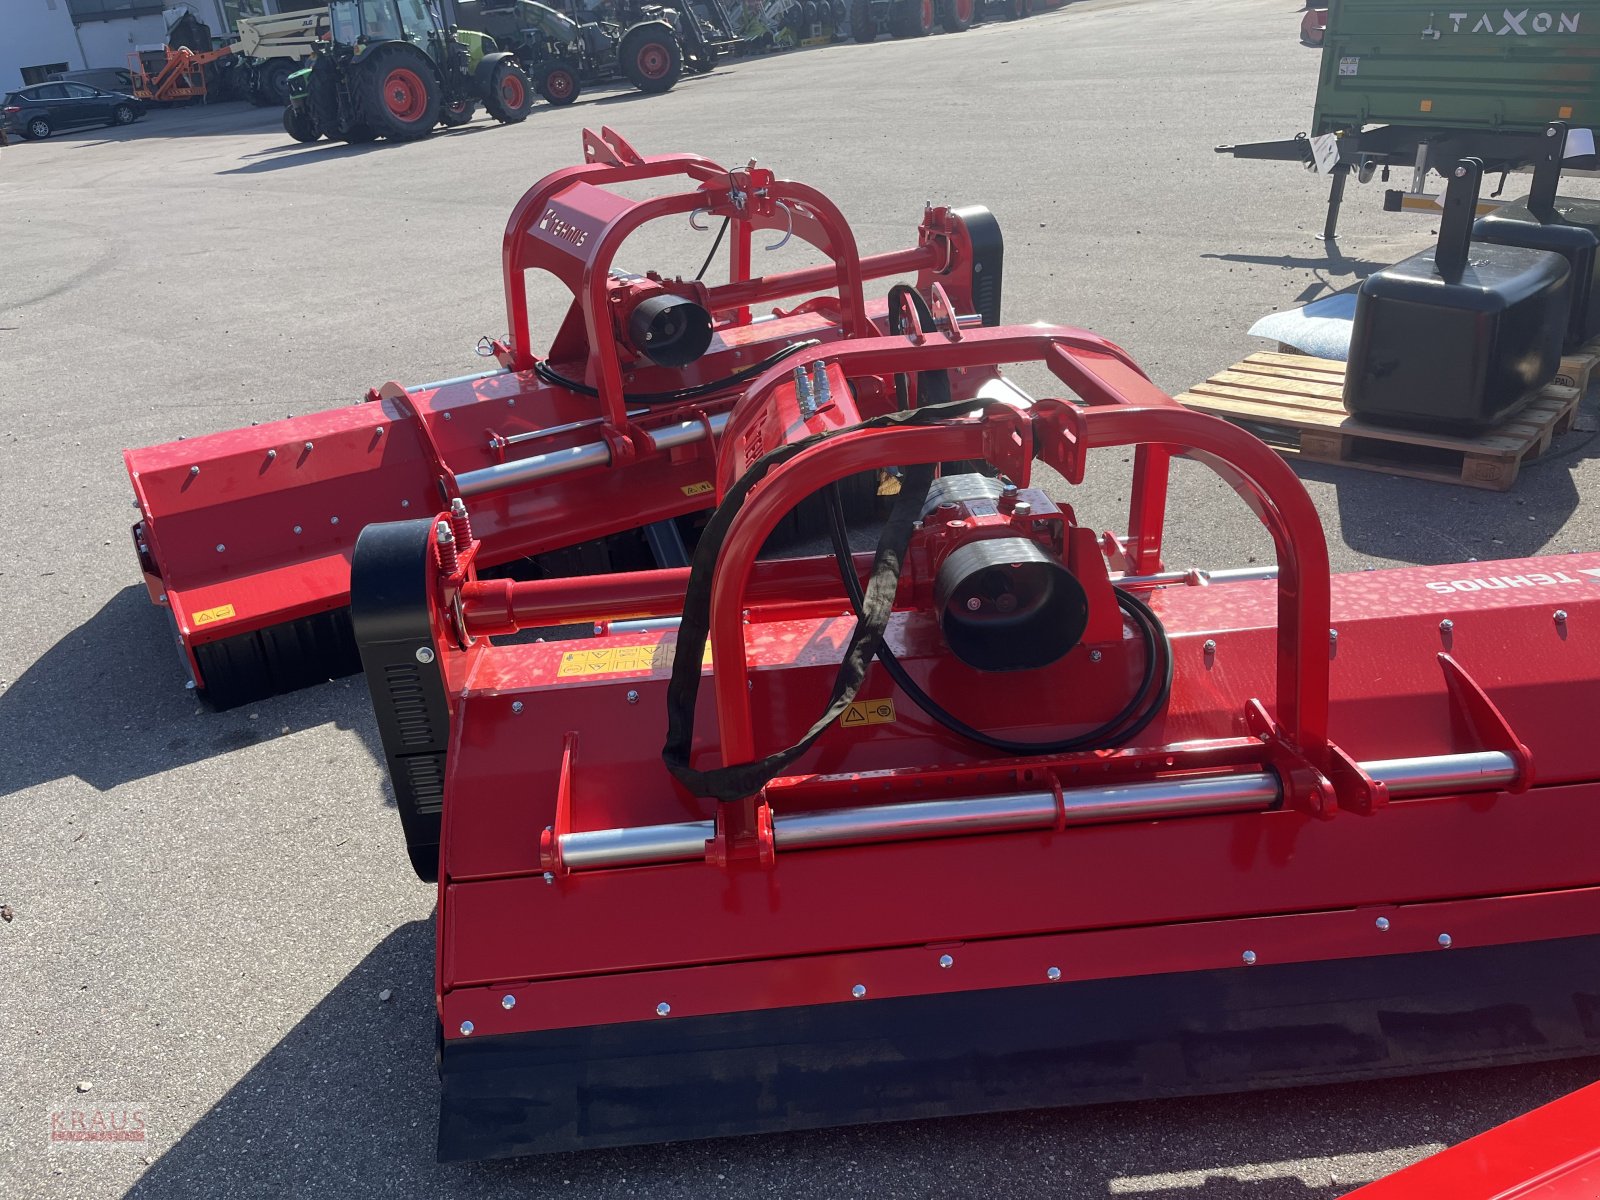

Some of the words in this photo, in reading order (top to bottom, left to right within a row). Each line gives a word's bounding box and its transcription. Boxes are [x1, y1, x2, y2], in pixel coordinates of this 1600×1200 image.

[1448, 8, 1581, 36] TAXON
[548, 218, 588, 247] TEHNOS
[1425, 571, 1581, 594] TEHNOS
